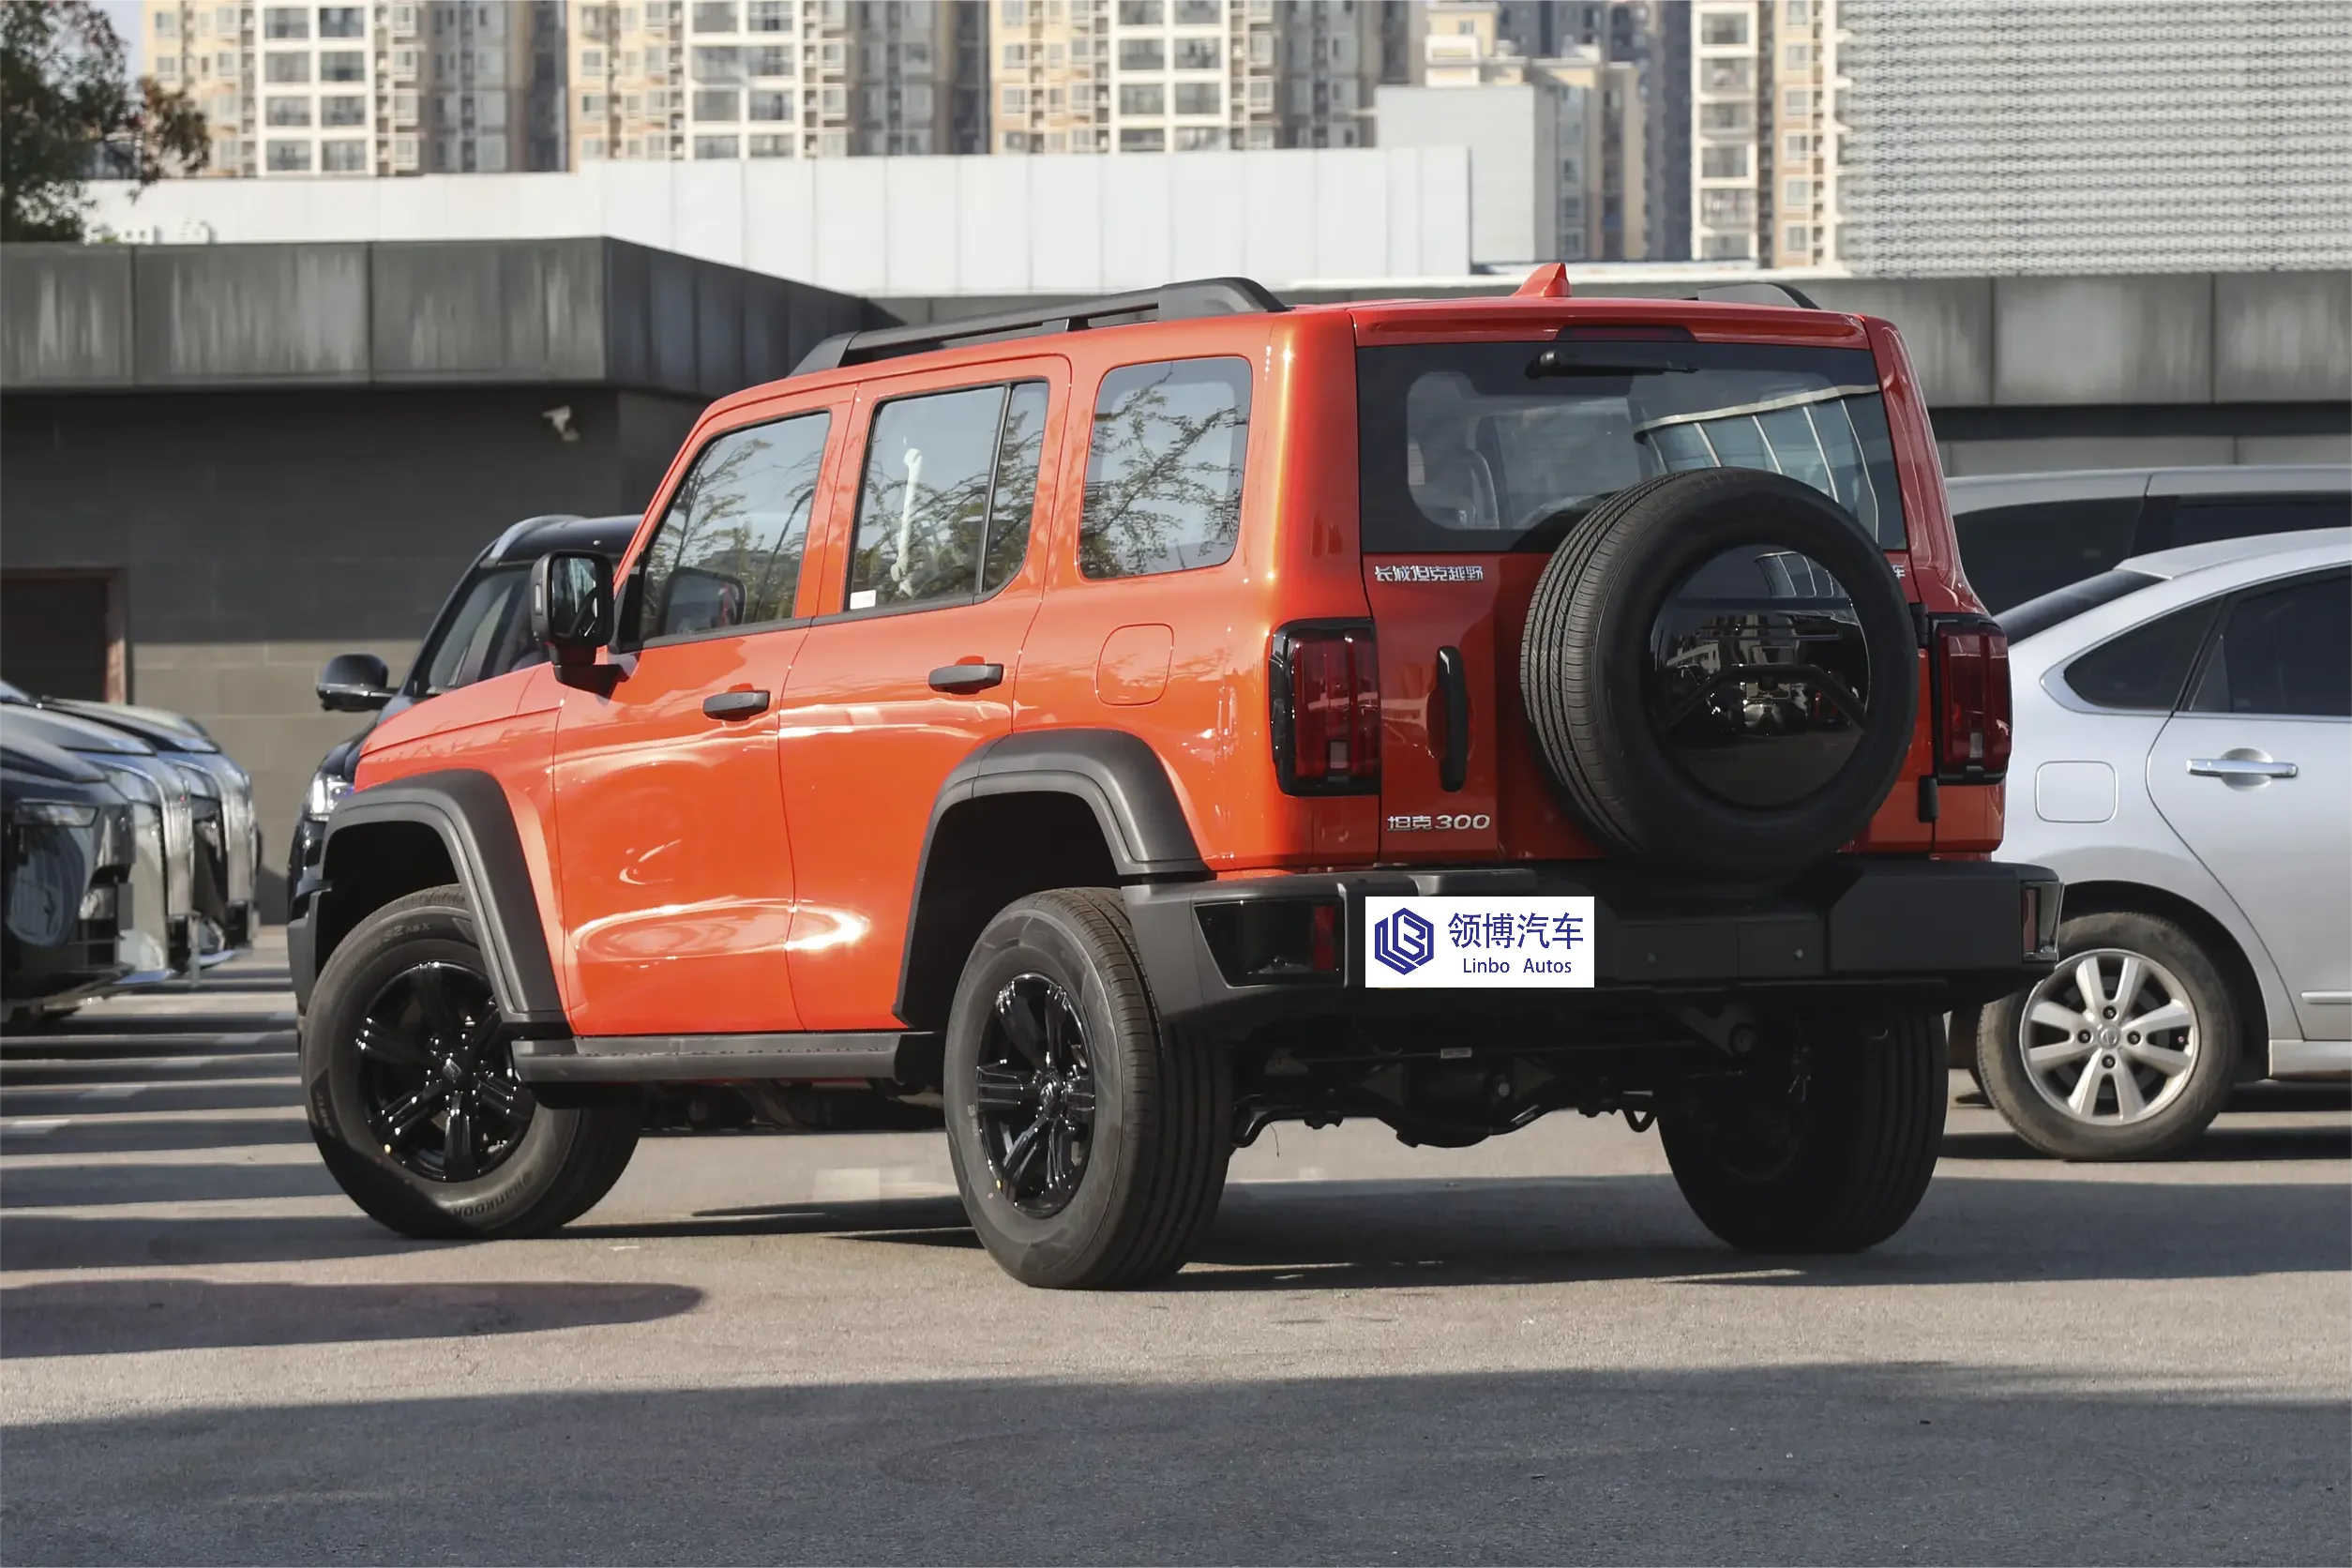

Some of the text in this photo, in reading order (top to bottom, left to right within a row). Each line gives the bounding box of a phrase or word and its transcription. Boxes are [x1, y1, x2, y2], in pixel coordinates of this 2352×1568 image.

[1375, 565, 1483, 581] 长城坦克越野
